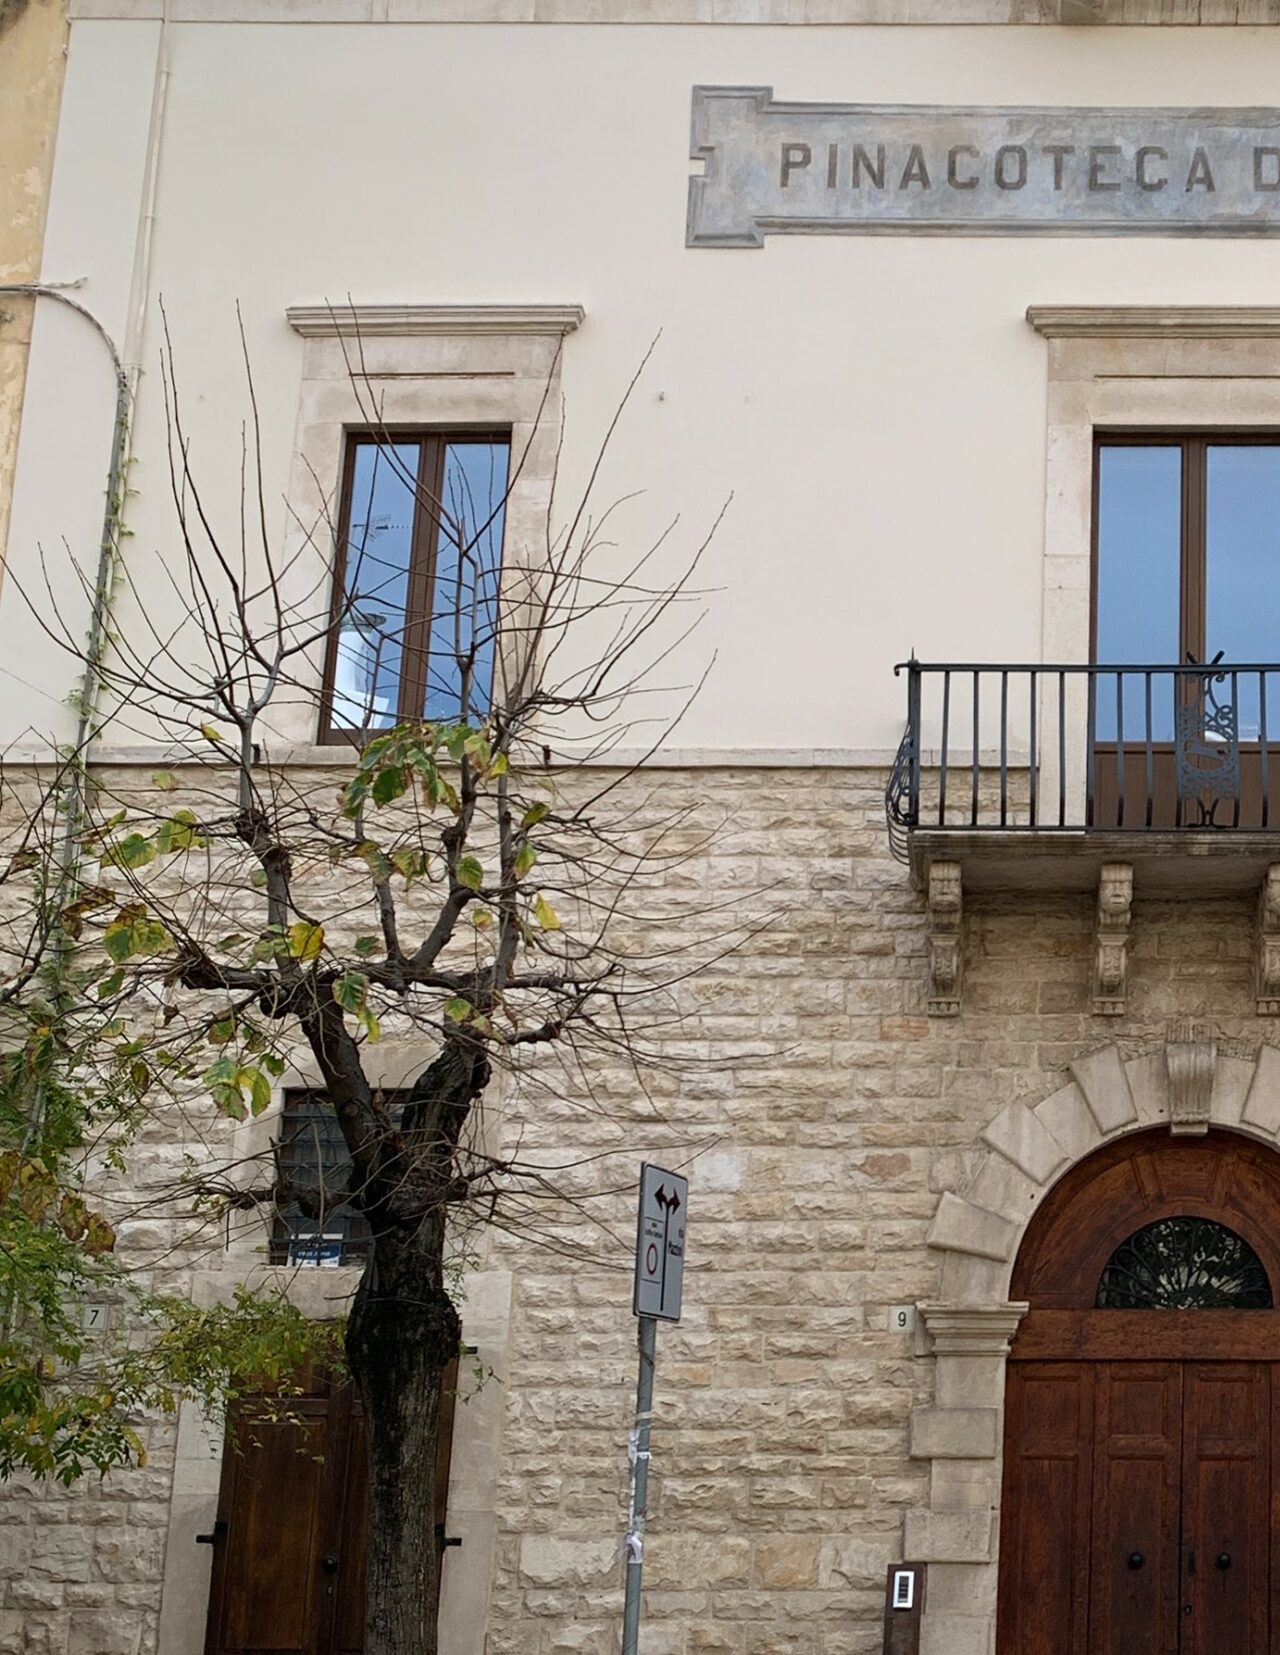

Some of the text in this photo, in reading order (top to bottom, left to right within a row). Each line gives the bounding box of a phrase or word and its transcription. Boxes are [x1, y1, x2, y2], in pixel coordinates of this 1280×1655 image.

[779, 142, 1216, 192] PINACOTECA
[90, 1309, 99, 1325] 7
[898, 1311, 907, 1327] 9
